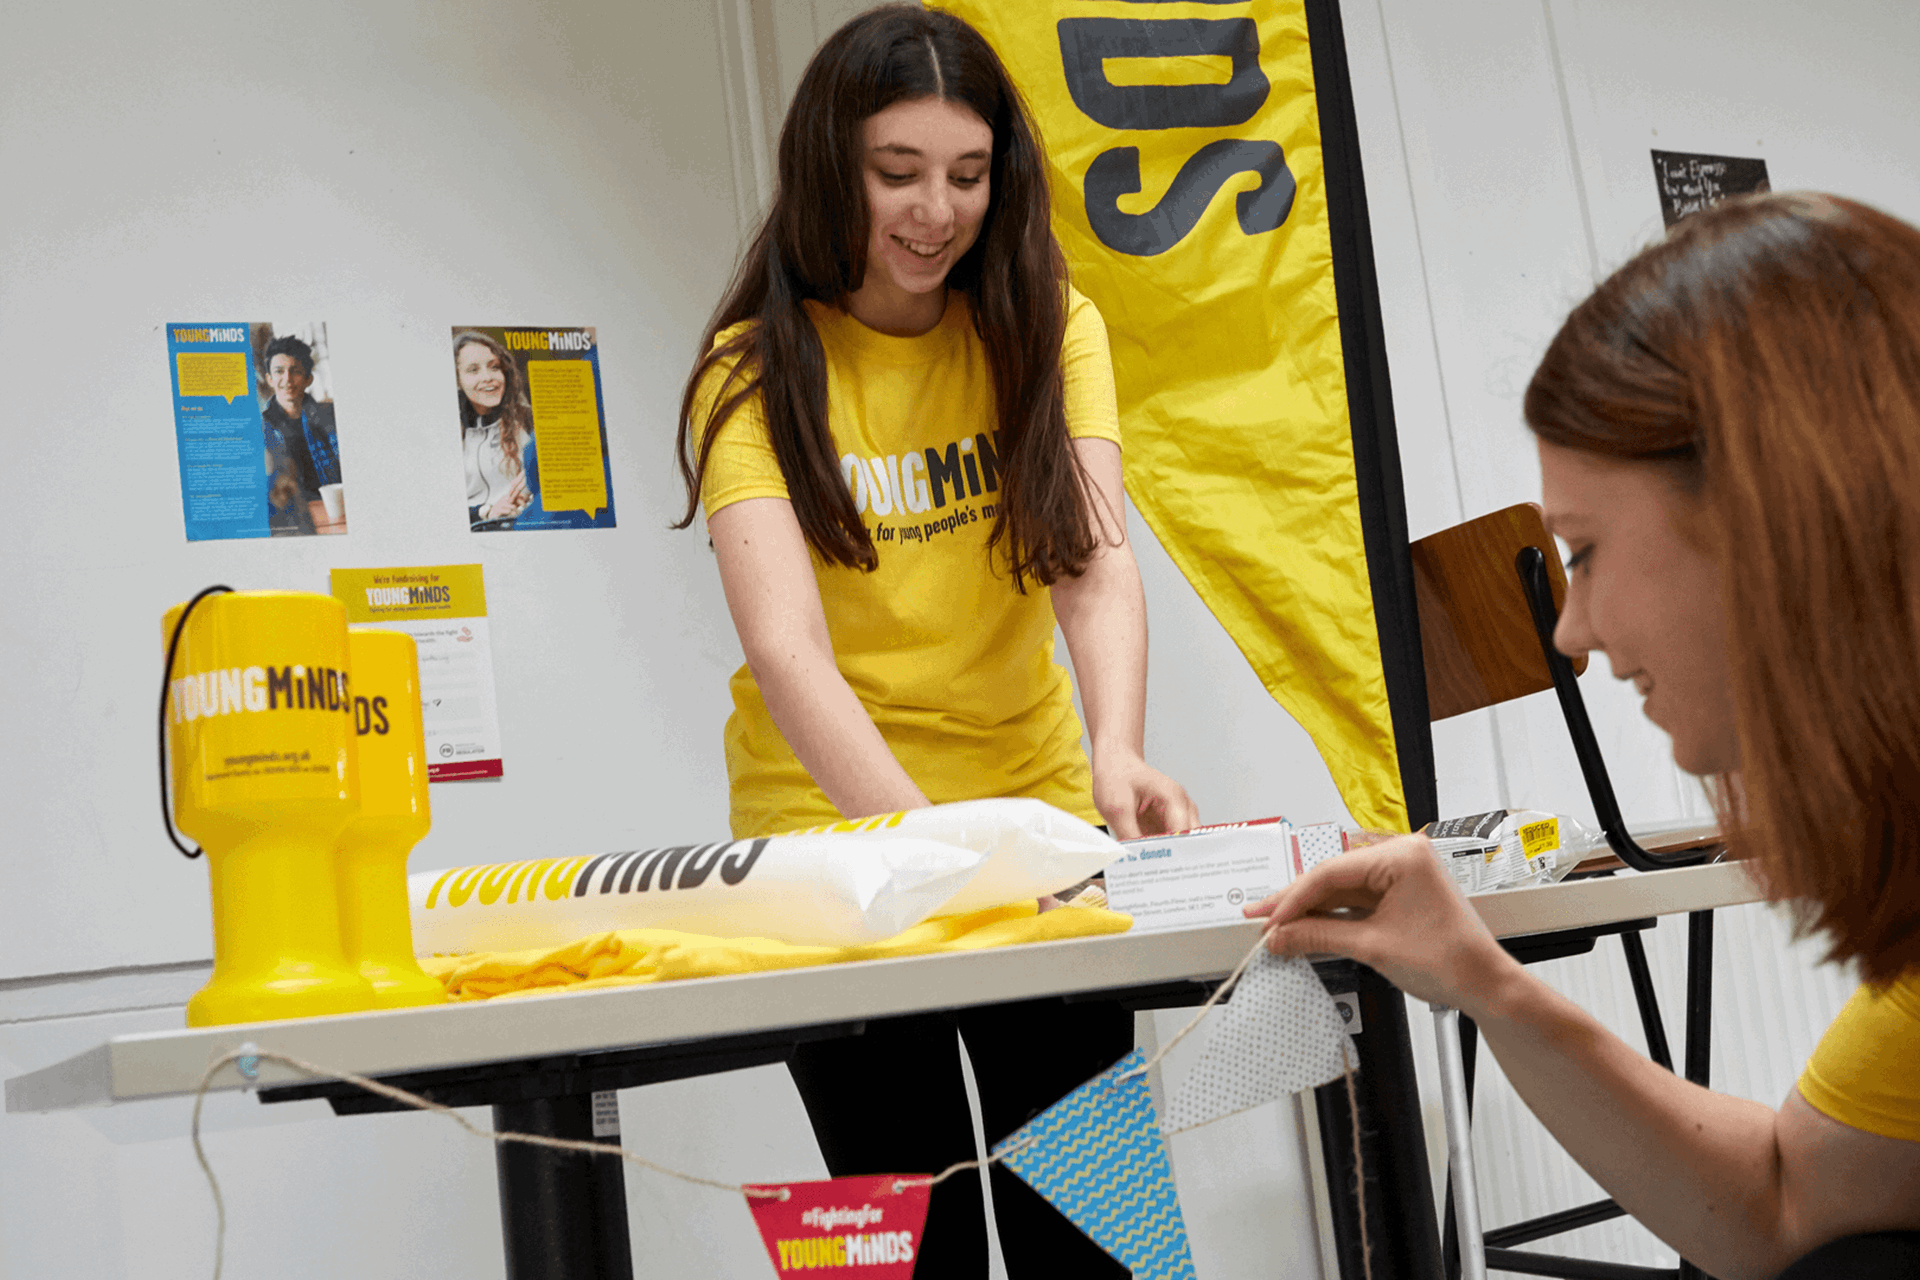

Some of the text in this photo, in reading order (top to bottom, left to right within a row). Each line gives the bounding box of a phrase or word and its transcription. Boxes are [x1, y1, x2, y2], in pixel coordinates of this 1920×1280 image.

[876, 522, 896, 541] for
[924, 505, 978, 542] people's
[354, 695, 390, 736] DS
[1139, 847, 1172, 861] donate
[776, 1230, 915, 1271] YOUNGMiNDS
